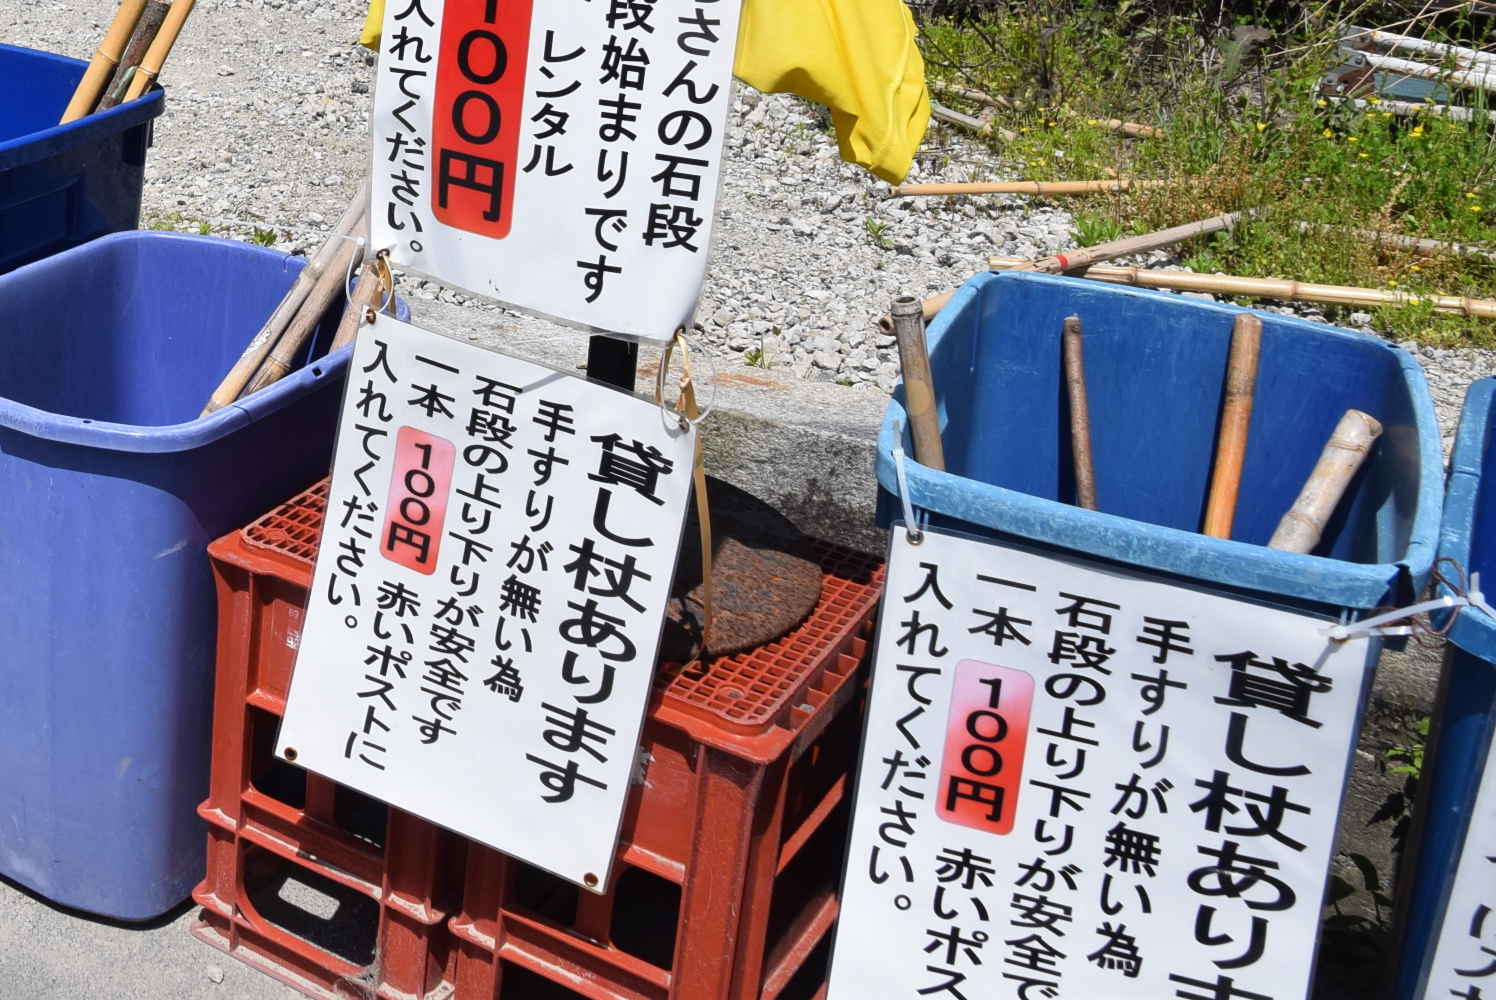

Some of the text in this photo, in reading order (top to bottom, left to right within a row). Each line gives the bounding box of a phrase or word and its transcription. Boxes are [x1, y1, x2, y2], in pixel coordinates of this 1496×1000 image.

[522, 29, 586, 177] レンタル
[327, 339, 398, 629] 入れてください。
[344, 354, 460, 771] 一本 100円 赤いポストに
[412, 375, 524, 745] 石段の上り下りが安全です
[483, 399, 576, 703] 手すりが無い為
[525, 434, 674, 804] 貸し杖あります
[967, 574, 1037, 647] 一本
[869, 561, 954, 911] 入れてください。
[944, 676, 1007, 824] 100円
[1087, 616, 1194, 979] 手すりが無い為
